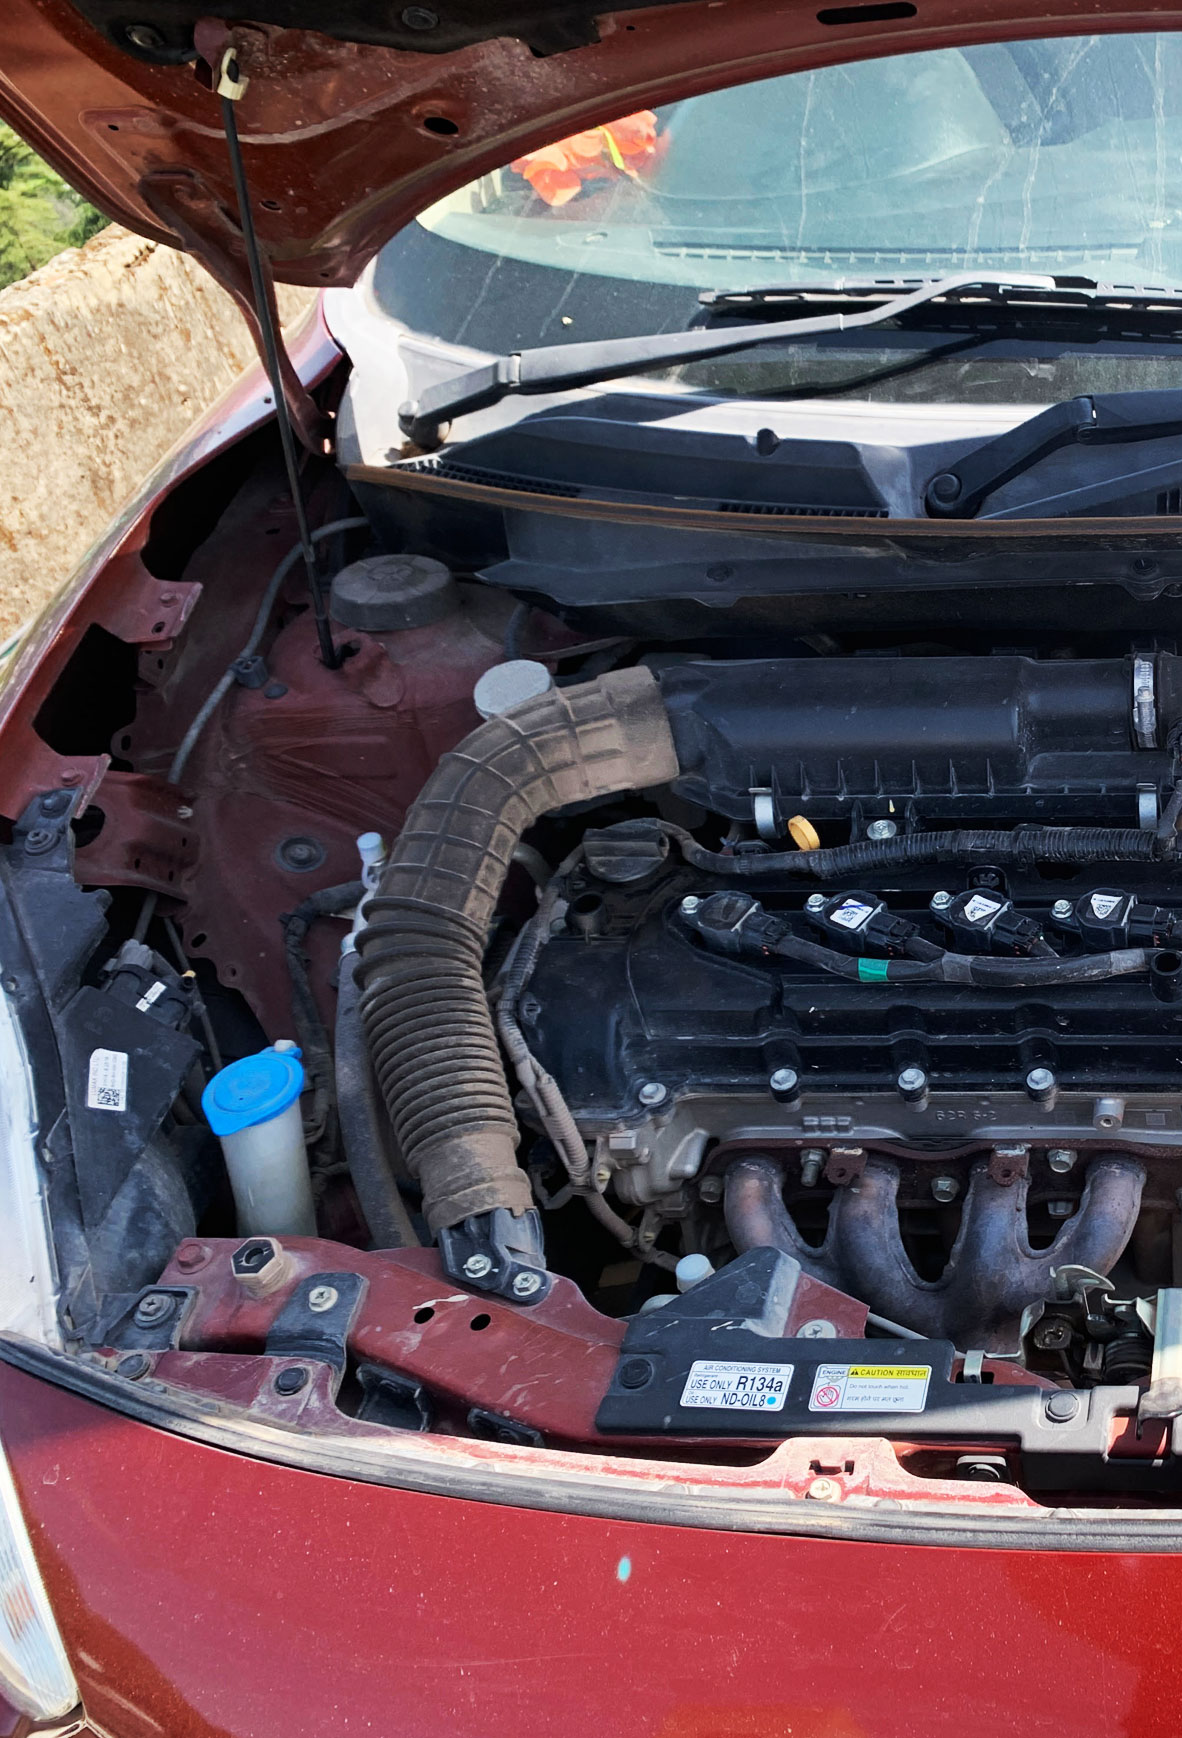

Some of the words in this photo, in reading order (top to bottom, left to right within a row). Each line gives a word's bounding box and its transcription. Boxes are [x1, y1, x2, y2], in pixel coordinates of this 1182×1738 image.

[715, 1365, 756, 1373] CONDITIONING
[690, 1379, 708, 1389] USE
[709, 1380, 733, 1390] ONLY
[736, 1375, 784, 1392] R134a
[685, 1396, 698, 1404] USE
[699, 1396, 718, 1405] ONLY
[720, 1392, 767, 1407] ND-OIL8
